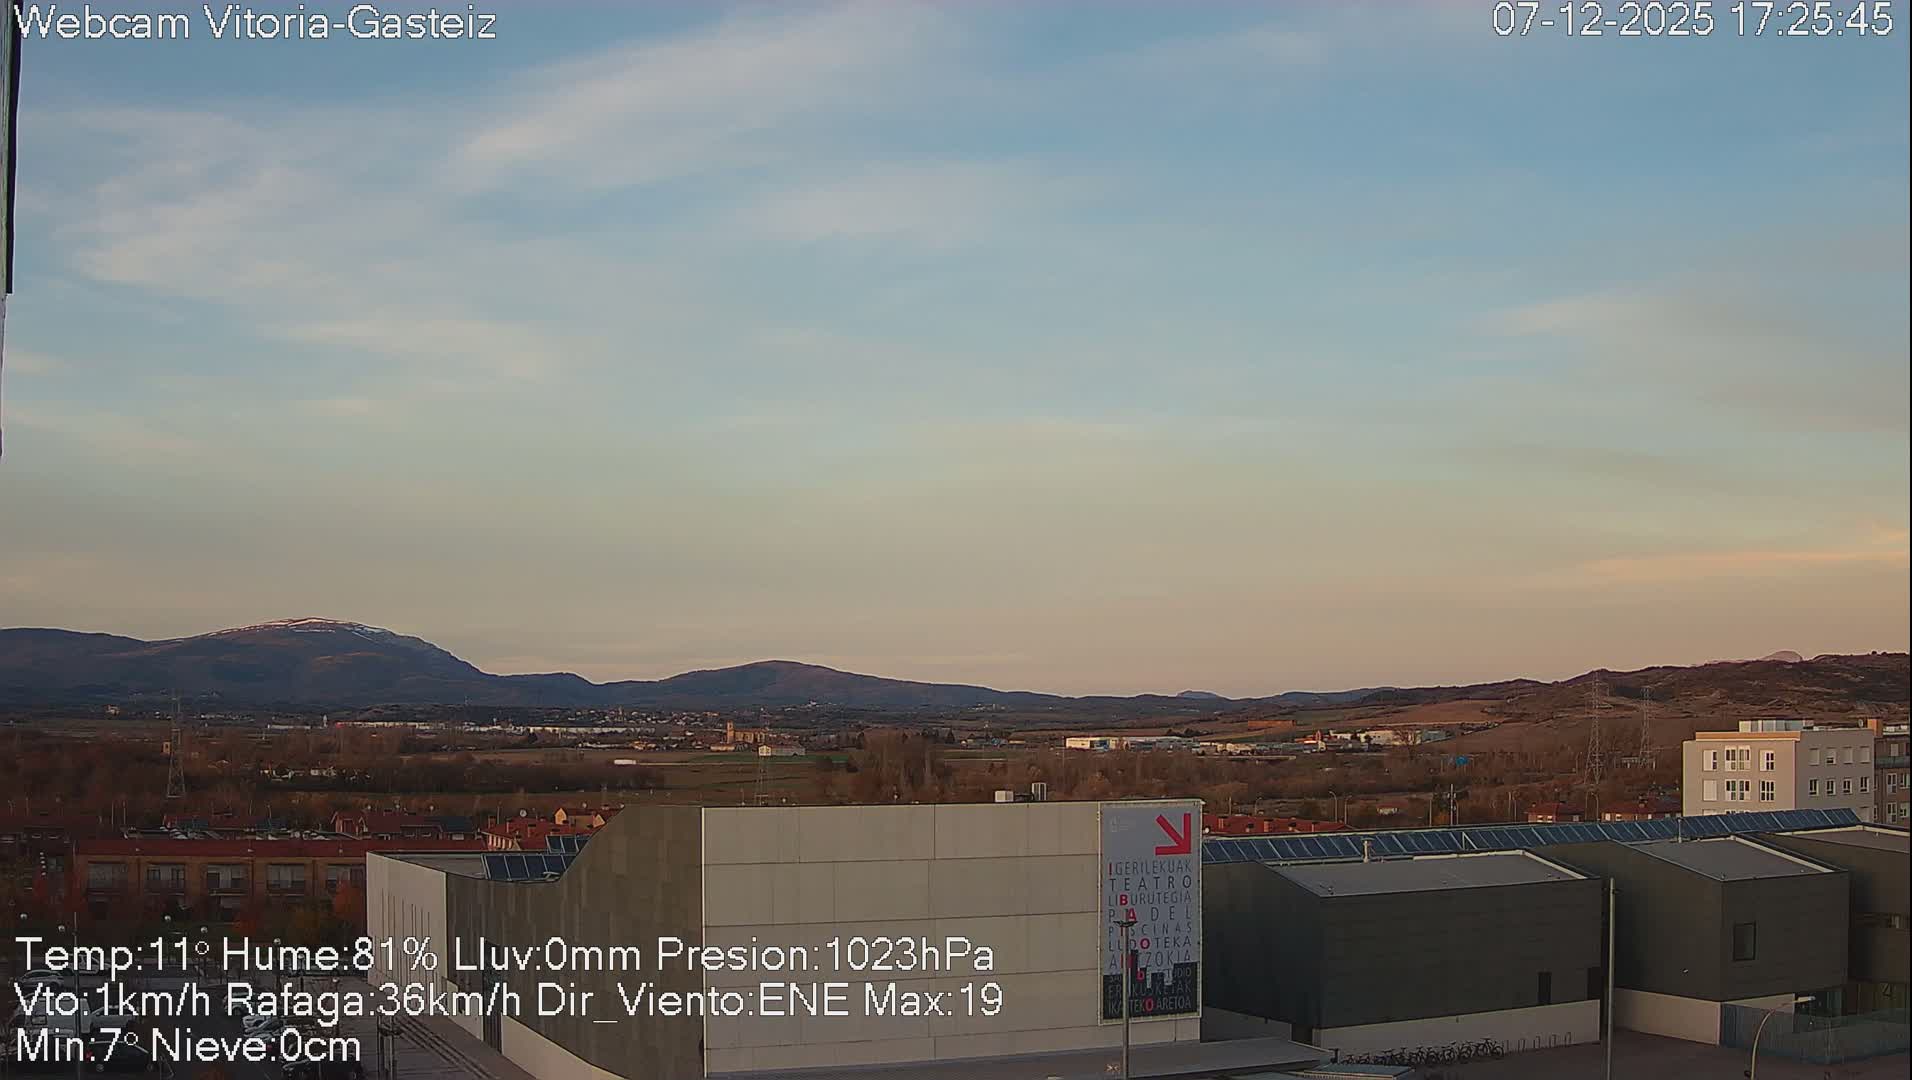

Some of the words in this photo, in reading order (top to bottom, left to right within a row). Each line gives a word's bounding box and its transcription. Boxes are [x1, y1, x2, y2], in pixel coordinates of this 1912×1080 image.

[1108, 860, 1192, 876] IGERILEKUAK
[1108, 875, 1192, 891] TEATRO
[1108, 890, 1192, 907] LIBURUTEGIA
[1108, 905, 1192, 923] PADEL
[1108, 922, 1192, 937] PISCINAS
